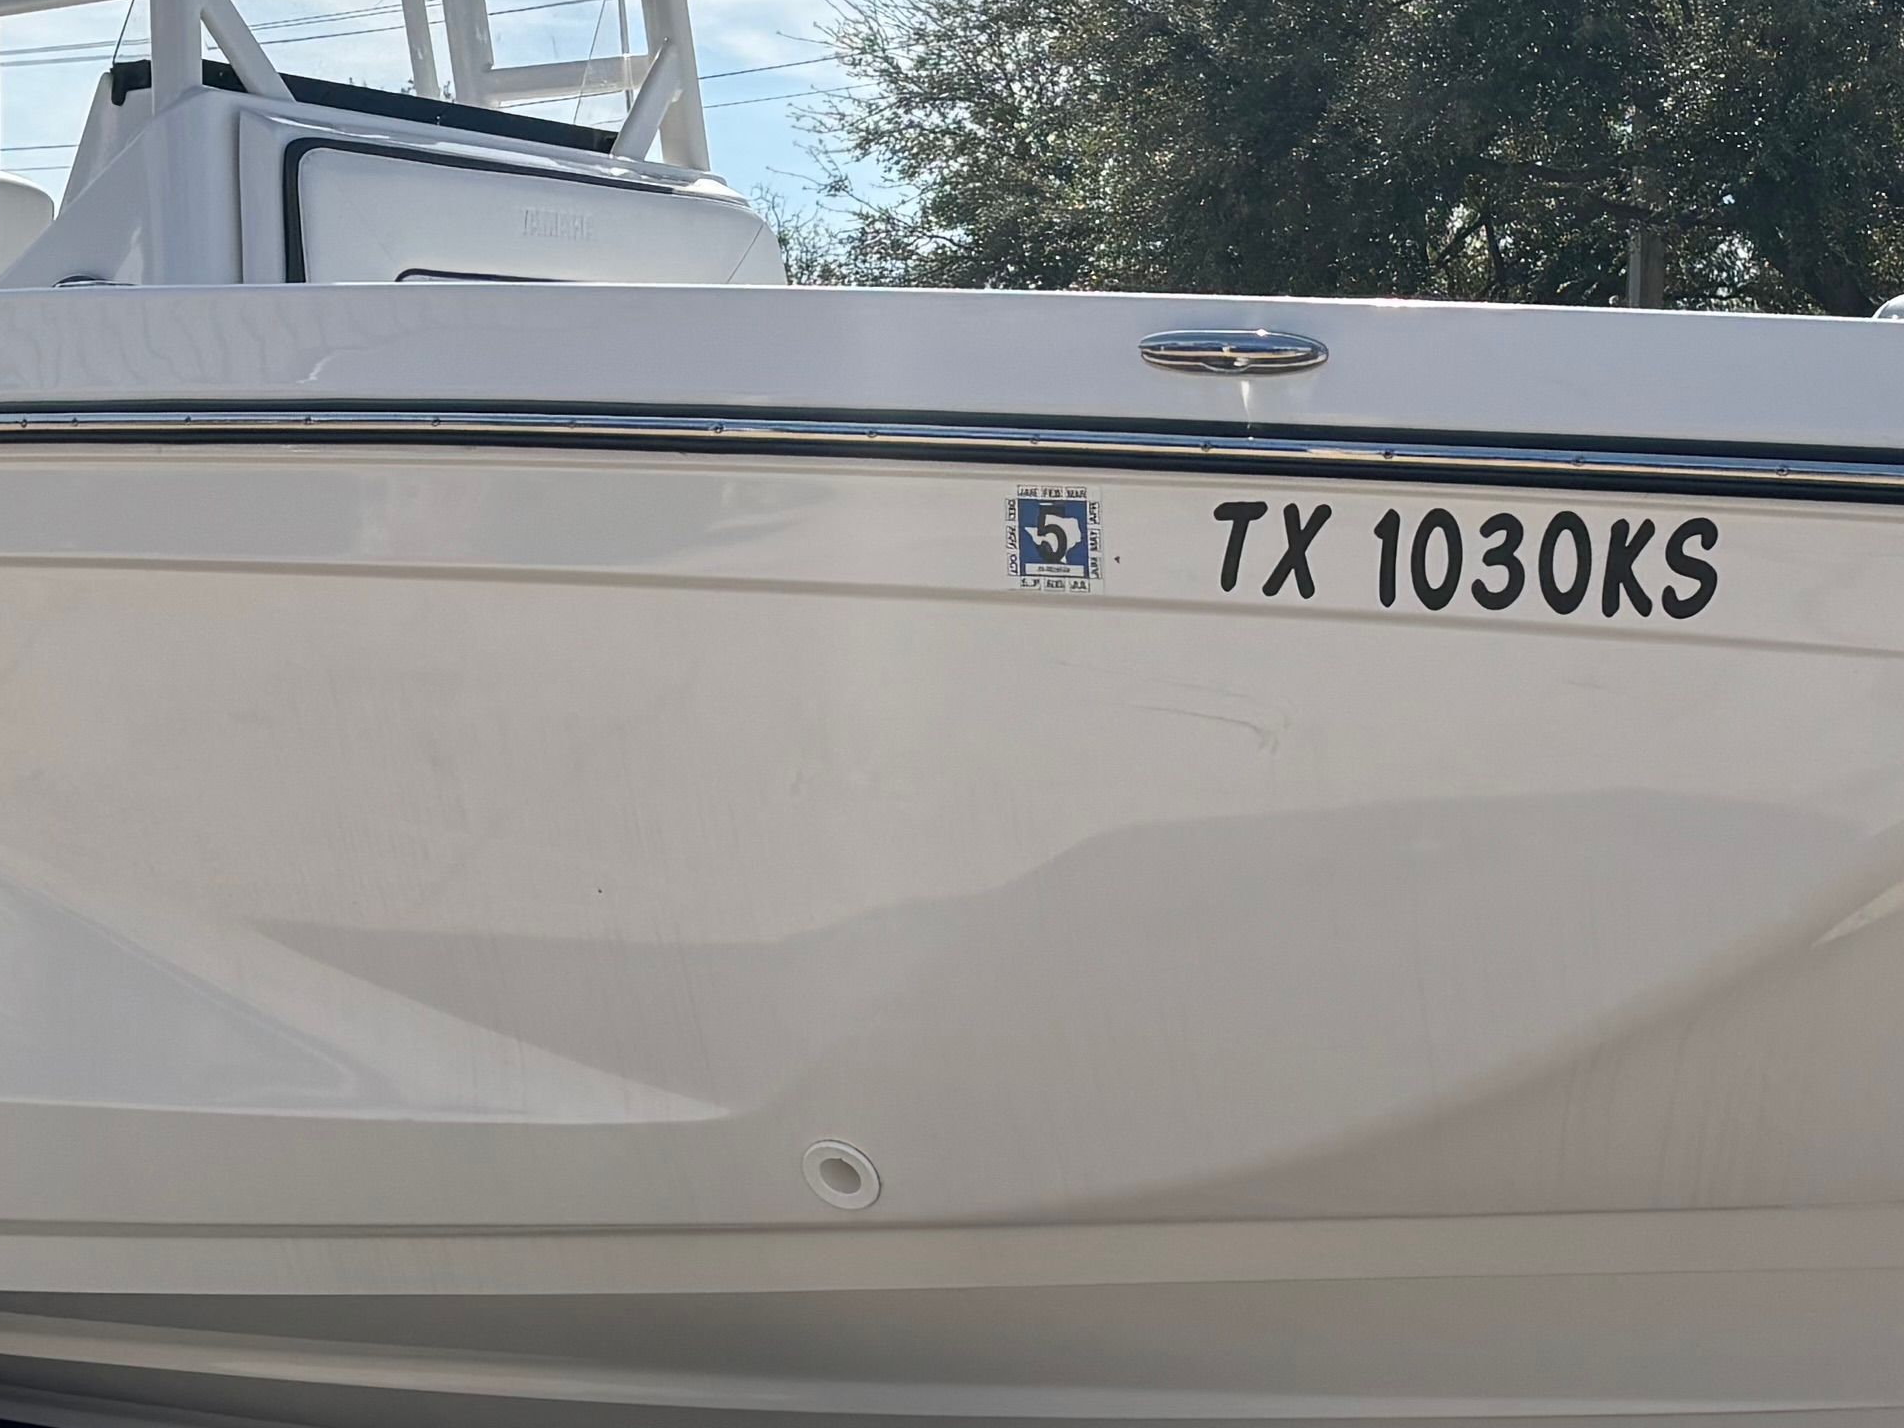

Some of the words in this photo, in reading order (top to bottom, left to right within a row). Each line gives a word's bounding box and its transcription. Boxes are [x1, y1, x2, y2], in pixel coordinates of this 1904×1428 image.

[1037, 502, 1067, 564] 5
[1213, 501, 1332, 599] TX
[1373, 508, 1718, 619] 1030KS
